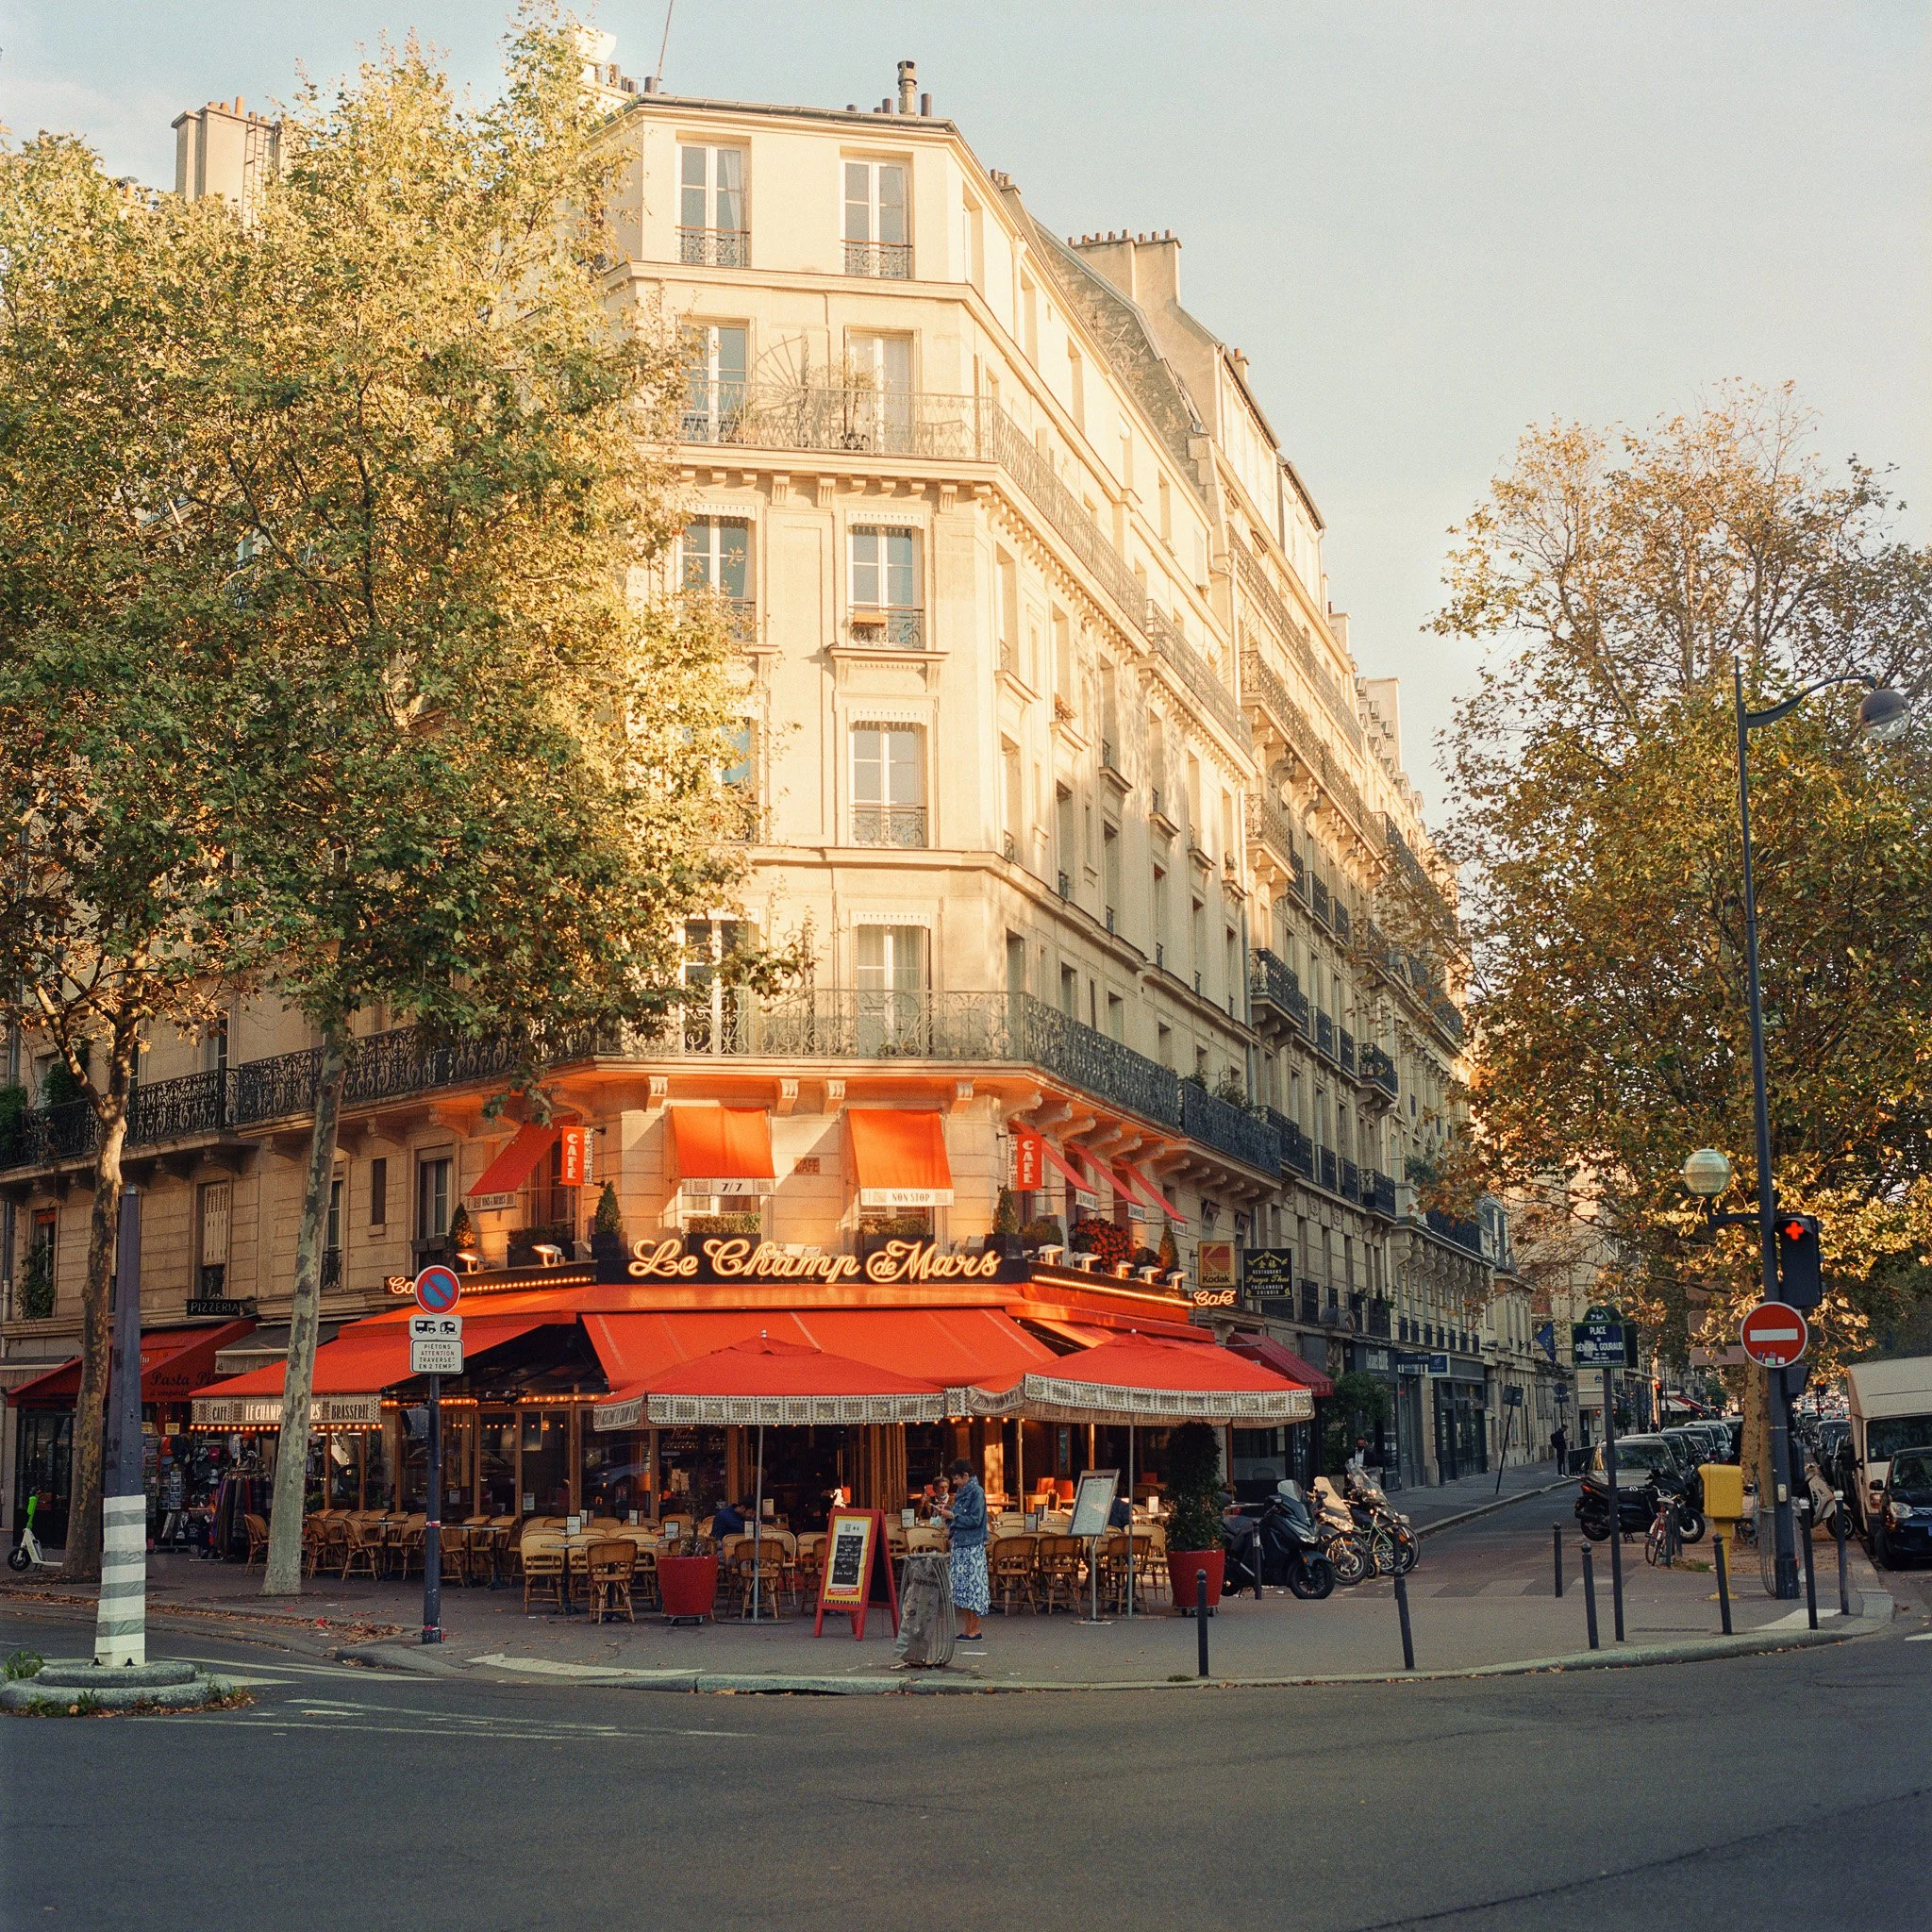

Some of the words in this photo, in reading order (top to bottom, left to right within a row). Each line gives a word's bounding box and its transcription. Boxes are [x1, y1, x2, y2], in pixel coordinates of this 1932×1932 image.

[722, 1182, 742, 1192] 7/7
[891, 1192, 908, 1202] NON
[910, 1192, 930, 1203] STOP
[627, 1238, 699, 1276] Le
[703, 1238, 861, 1284] Champ
[868, 1239, 1002, 1283] Mars
[871, 1254, 897, 1276] de
[389, 1276, 414, 1294] Ca
[1193, 1290, 1237, 1306] Café
[191, 1302, 239, 1312] PIZZERIA
[1589, 1326, 1607, 1335] PLACE
[1599, 1341, 1624, 1351] GOURAUD
[150, 1371, 190, 1386] Pasta
[245, 1406, 255, 1421] LE
[256, 1404, 282, 1421] CHAMP
[309, 1404, 321, 1421] RS
[331, 1405, 370, 1421] BRASSERIE
